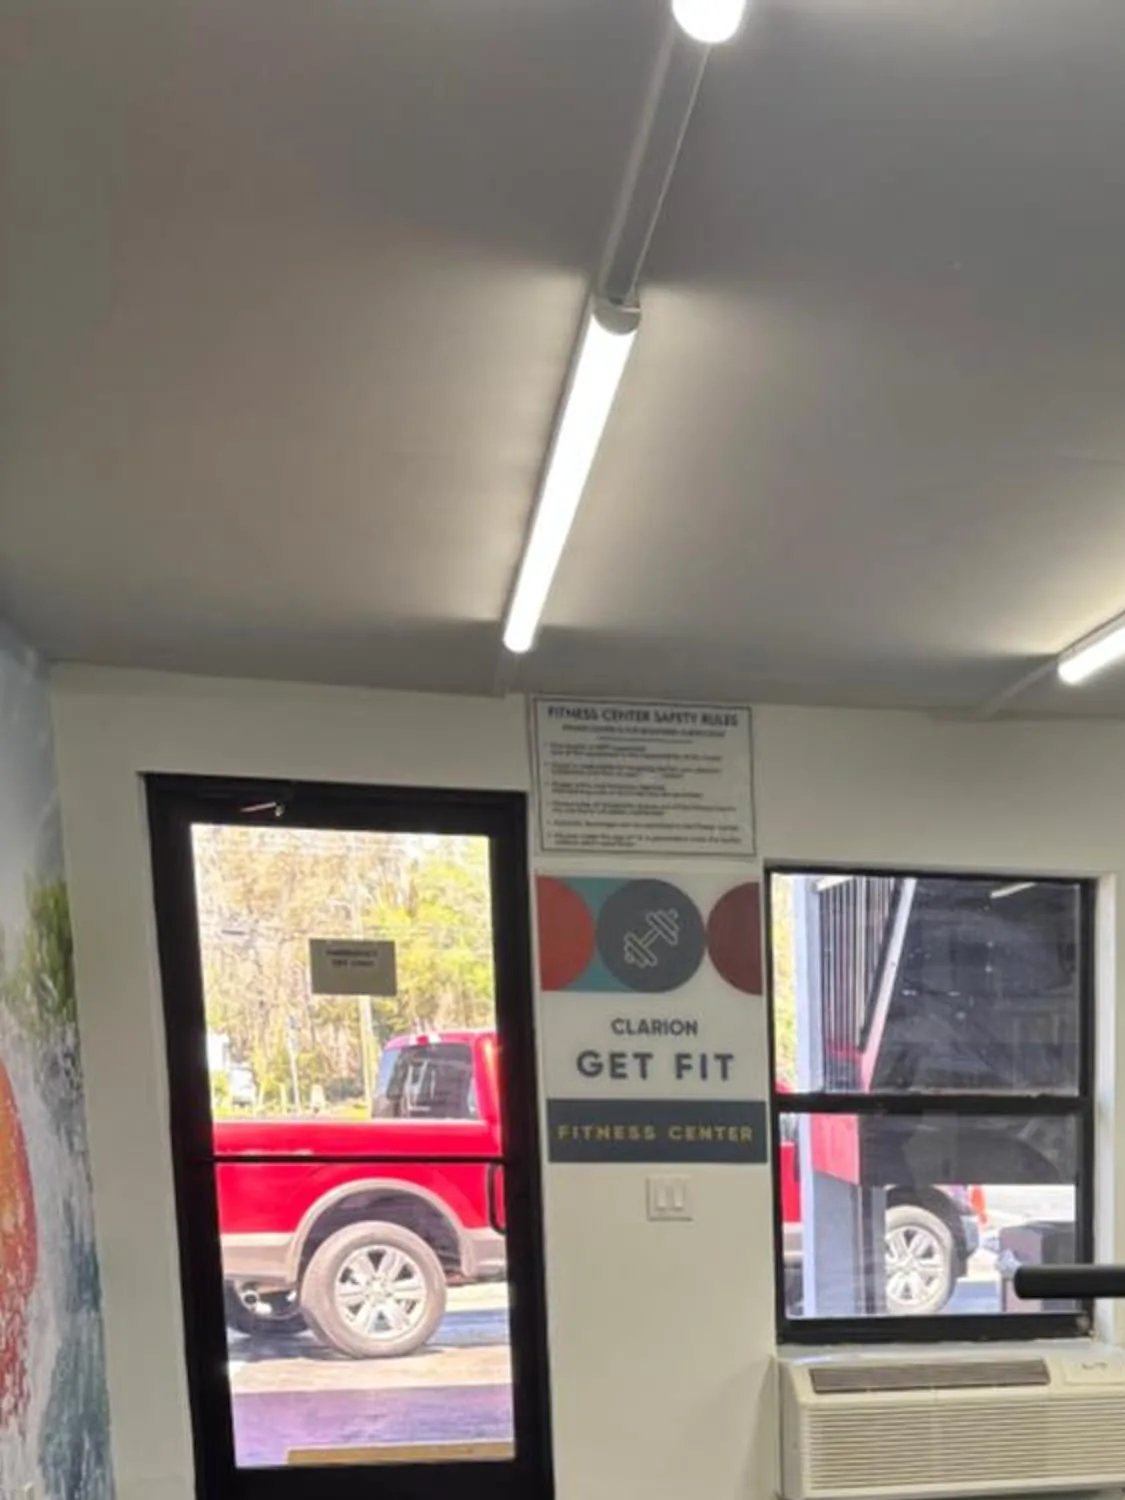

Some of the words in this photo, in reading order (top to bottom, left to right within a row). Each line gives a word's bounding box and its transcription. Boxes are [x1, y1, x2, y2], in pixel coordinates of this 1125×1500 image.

[548, 705, 598, 721] FITNESS
[601, 708, 649, 723] CENTER
[653, 710, 698, 726] SAFETY
[701, 712, 739, 728] RULES
[611, 1017, 698, 1037] CLARION
[576, 1050, 653, 1080] GET
[675, 1052, 735, 1081] FIT
[558, 1124, 655, 1141] FITNESS
[668, 1125, 753, 1142] CENTER
